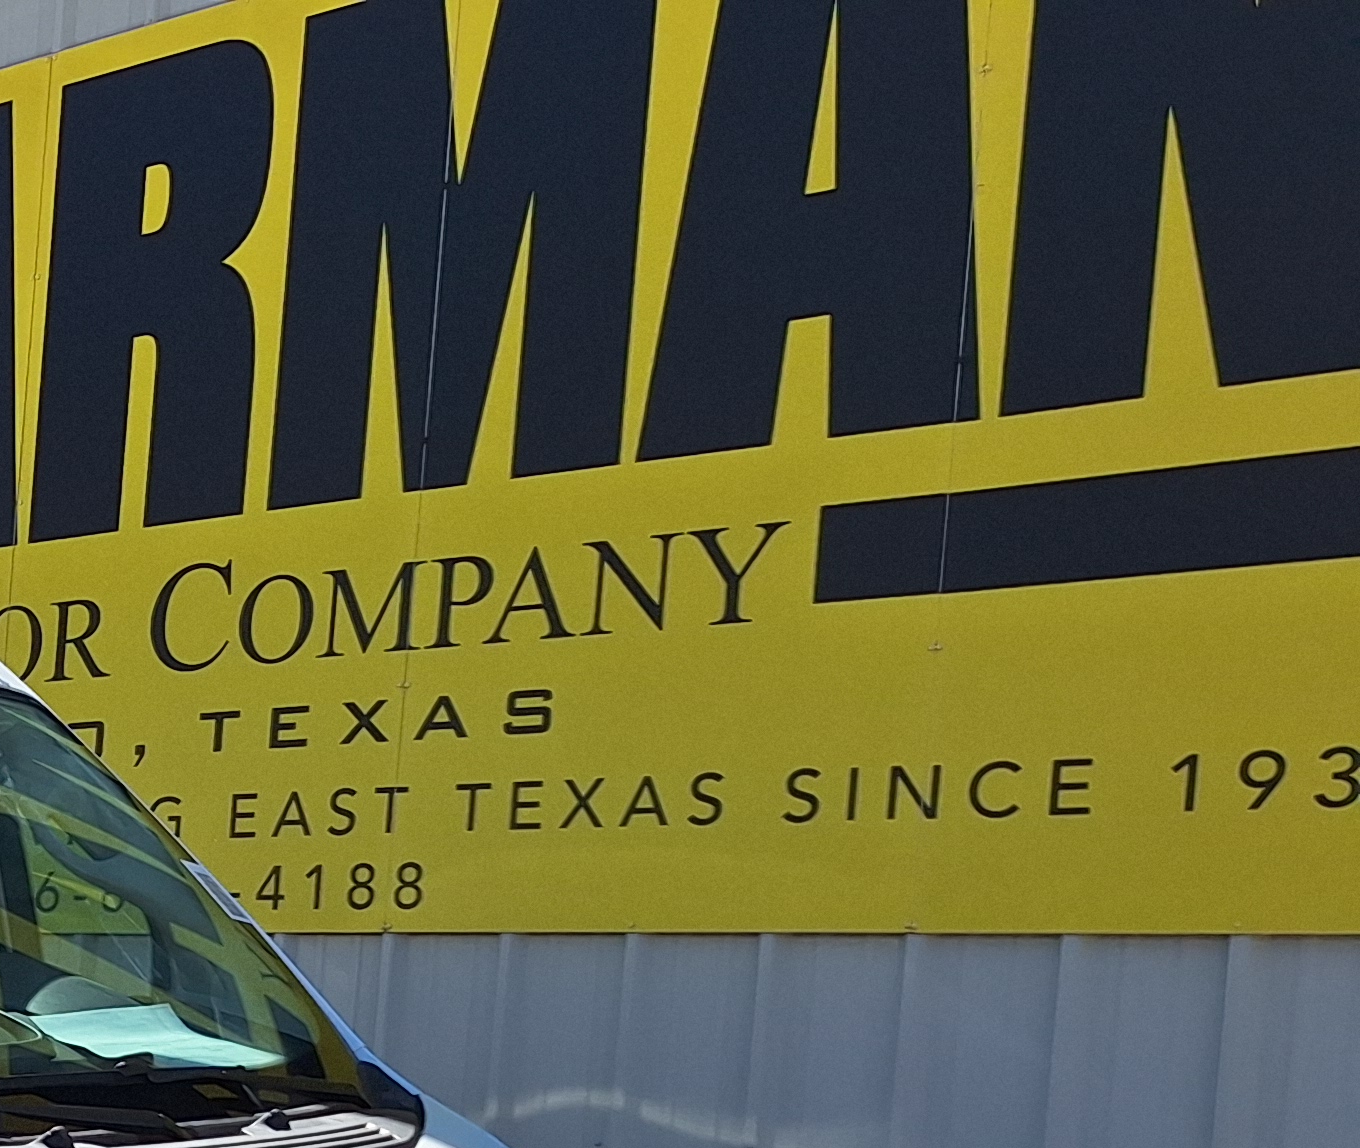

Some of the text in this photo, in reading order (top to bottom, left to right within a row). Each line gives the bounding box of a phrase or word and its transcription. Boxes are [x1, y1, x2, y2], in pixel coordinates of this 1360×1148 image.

[199, 689, 553, 753] TEXAS
[229, 786, 409, 838] EAST
[456, 772, 724, 831] TEXAS
[781, 758, 1093, 823] SINCE
